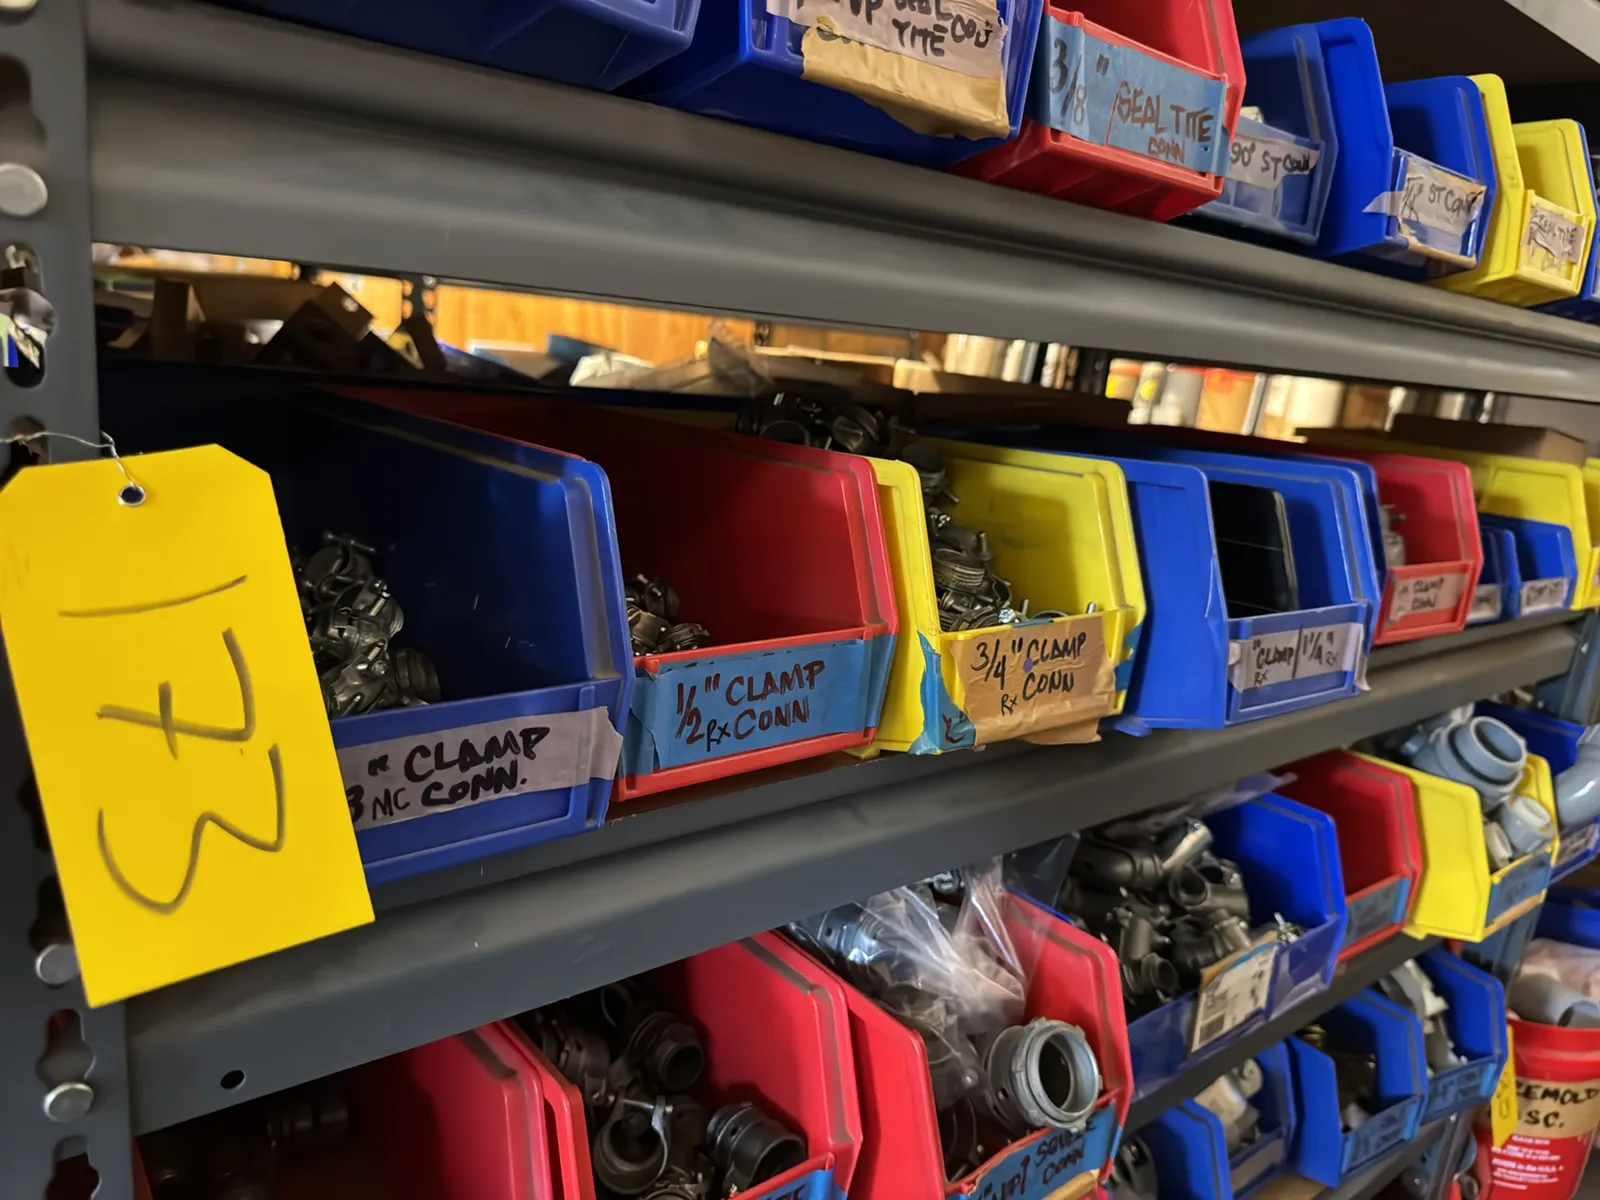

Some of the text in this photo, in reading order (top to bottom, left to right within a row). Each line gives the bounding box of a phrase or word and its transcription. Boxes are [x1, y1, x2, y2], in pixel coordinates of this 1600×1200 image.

[1026, 632, 1087, 667] CLAMP
[725, 660, 825, 707] CLAMP
[1022, 669, 1075, 701] CONN
[734, 697, 809, 740] CONN
[404, 727, 550, 783] CLAMP
[372, 787, 410, 821] MC
[1519, 1109, 1566, 1129] SC.
